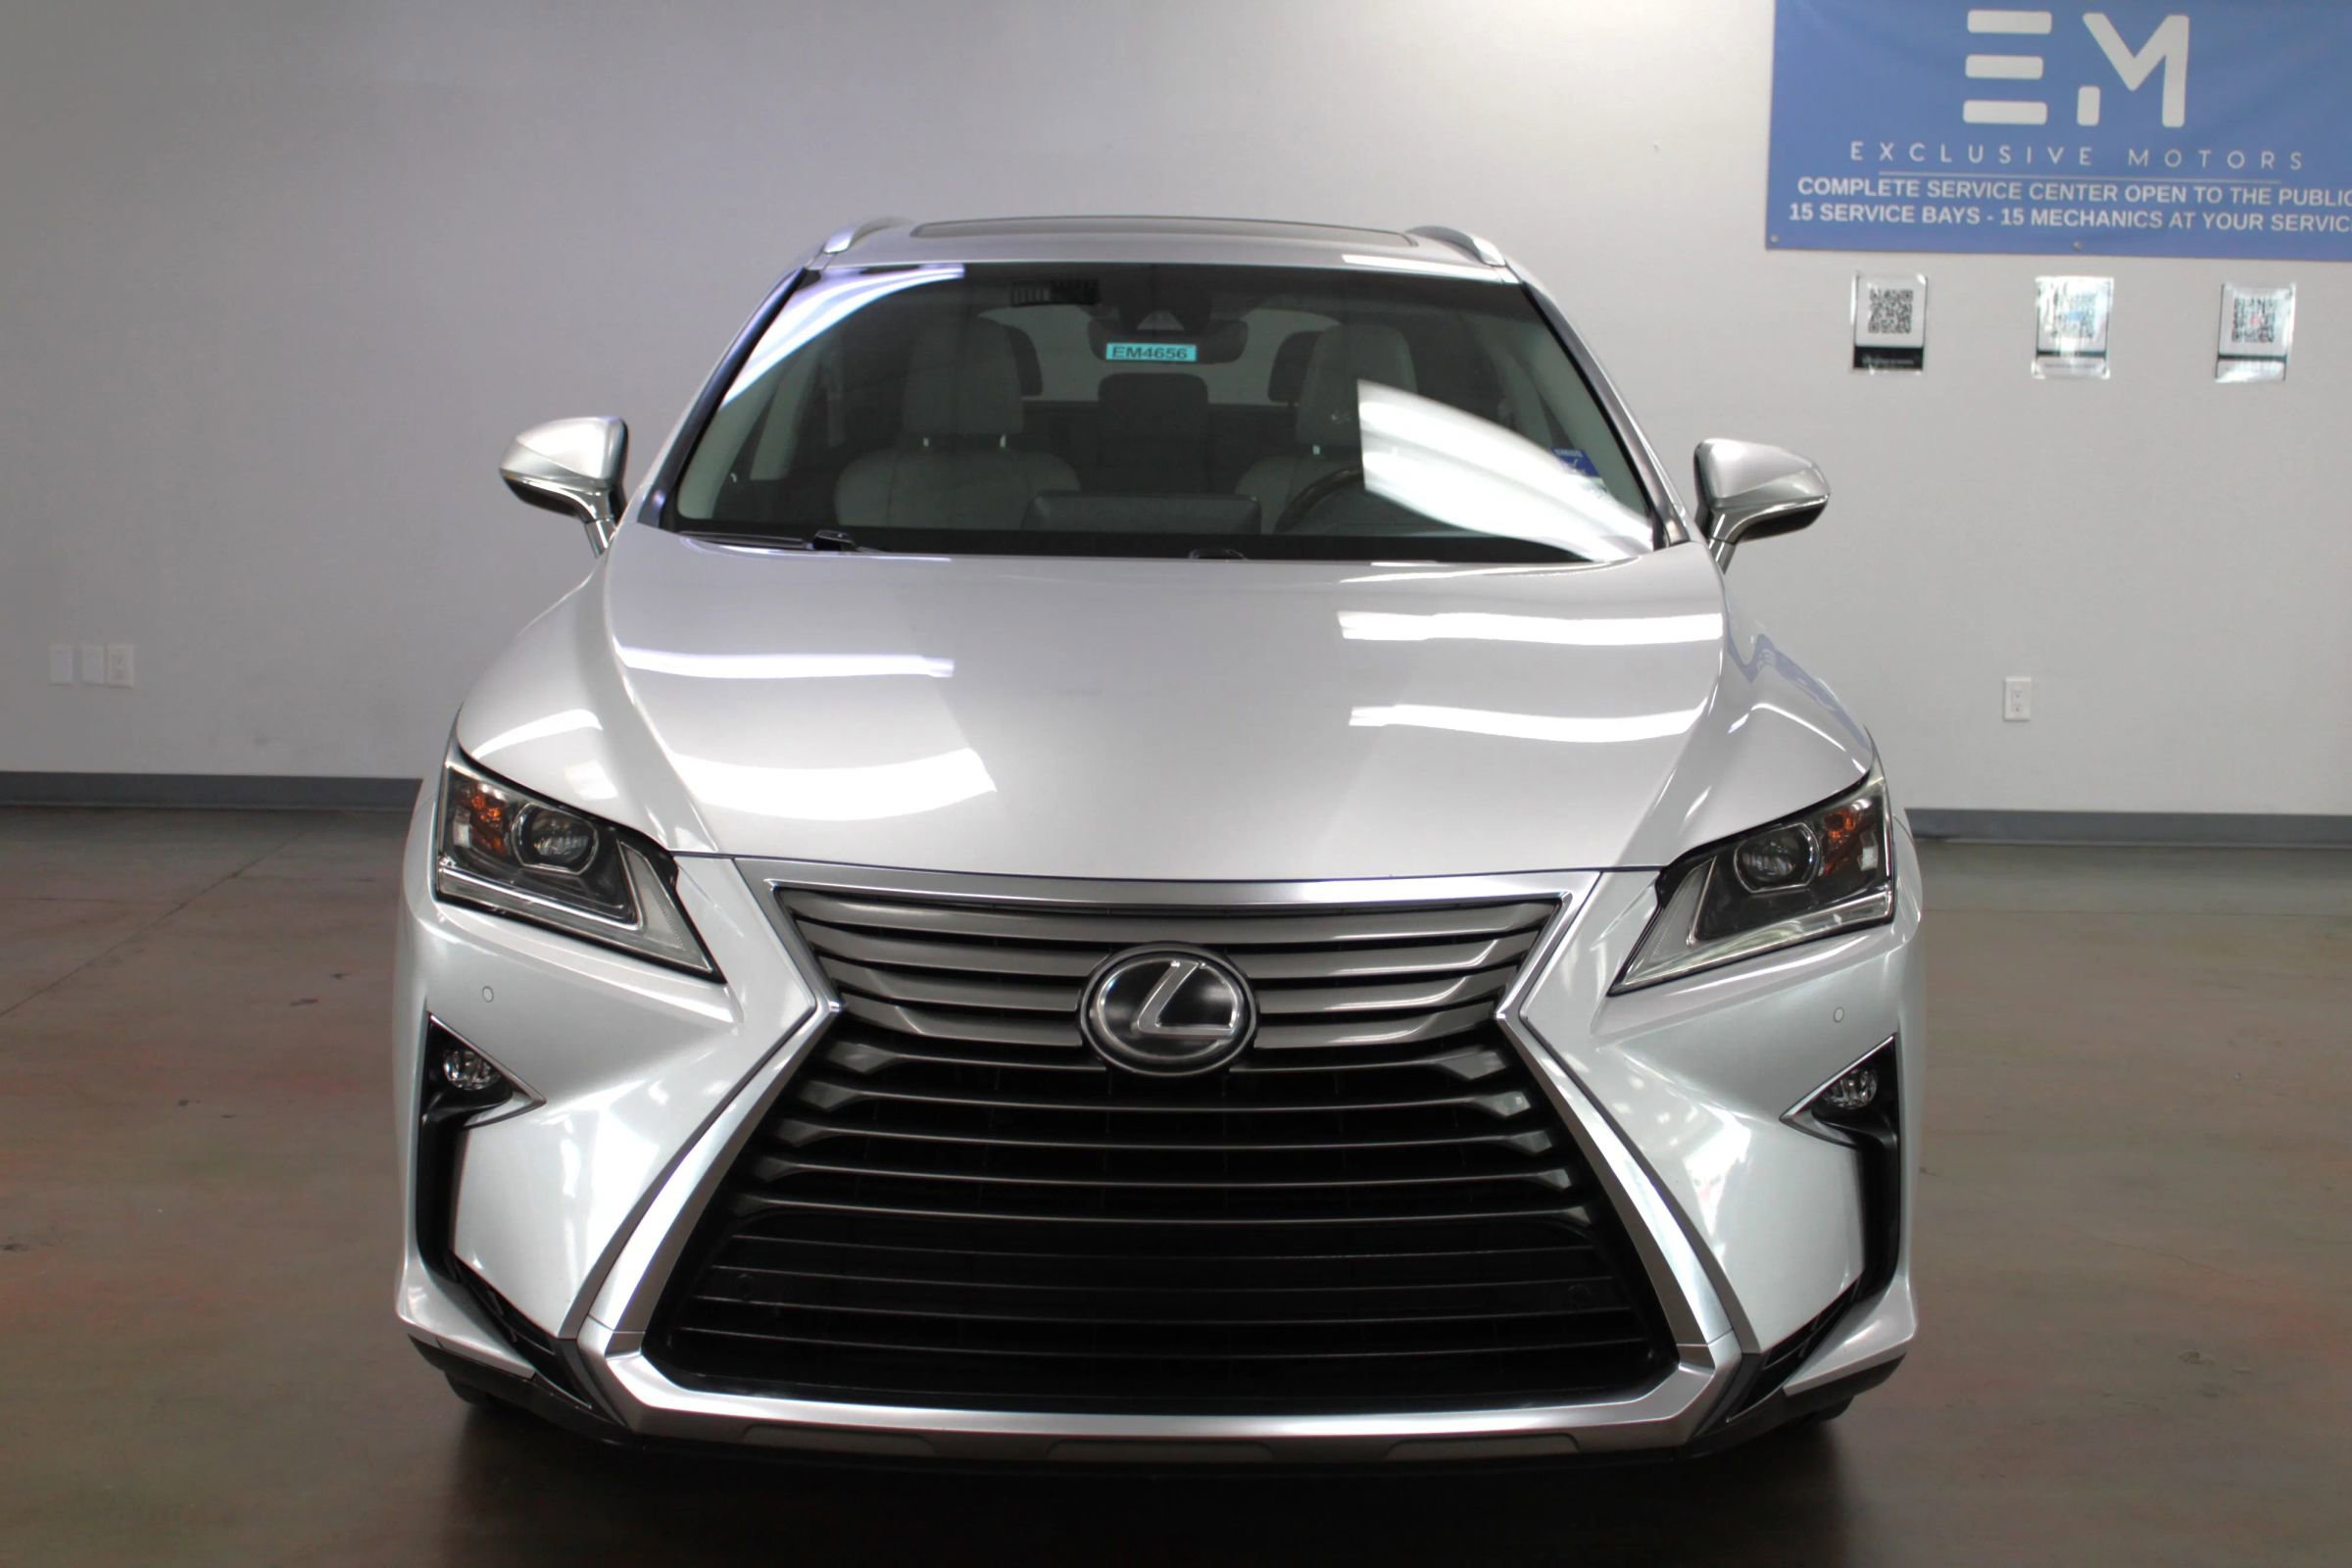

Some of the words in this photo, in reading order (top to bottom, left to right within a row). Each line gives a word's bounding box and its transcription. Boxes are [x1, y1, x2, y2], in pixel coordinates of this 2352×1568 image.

[1850, 141, 2092, 166] EXCLUSIVE
[2128, 149, 2305, 171] MOTORS
[1797, 176, 1921, 197] COMPLETE
[1927, 180, 2023, 200] SERVICE
[2029, 183, 2118, 202] CENTER
[2125, 185, 2186, 204] OPEN
[2193, 187, 2223, 204] TO
[2230, 187, 2272, 205] THE
[1788, 202, 1813, 220] 15
[1819, 204, 1915, 222] SERVICE
[1922, 206, 1981, 224] BAYS
[2000, 208, 2025, 225] 15
[2031, 209, 2163, 228] MECHANICS
[2168, 213, 2196, 228] AT
[2202, 212, 2264, 230] YOUR
[2270, 214, 2352, 232] SERVIC
[1112, 346, 1188, 359] EM4656
